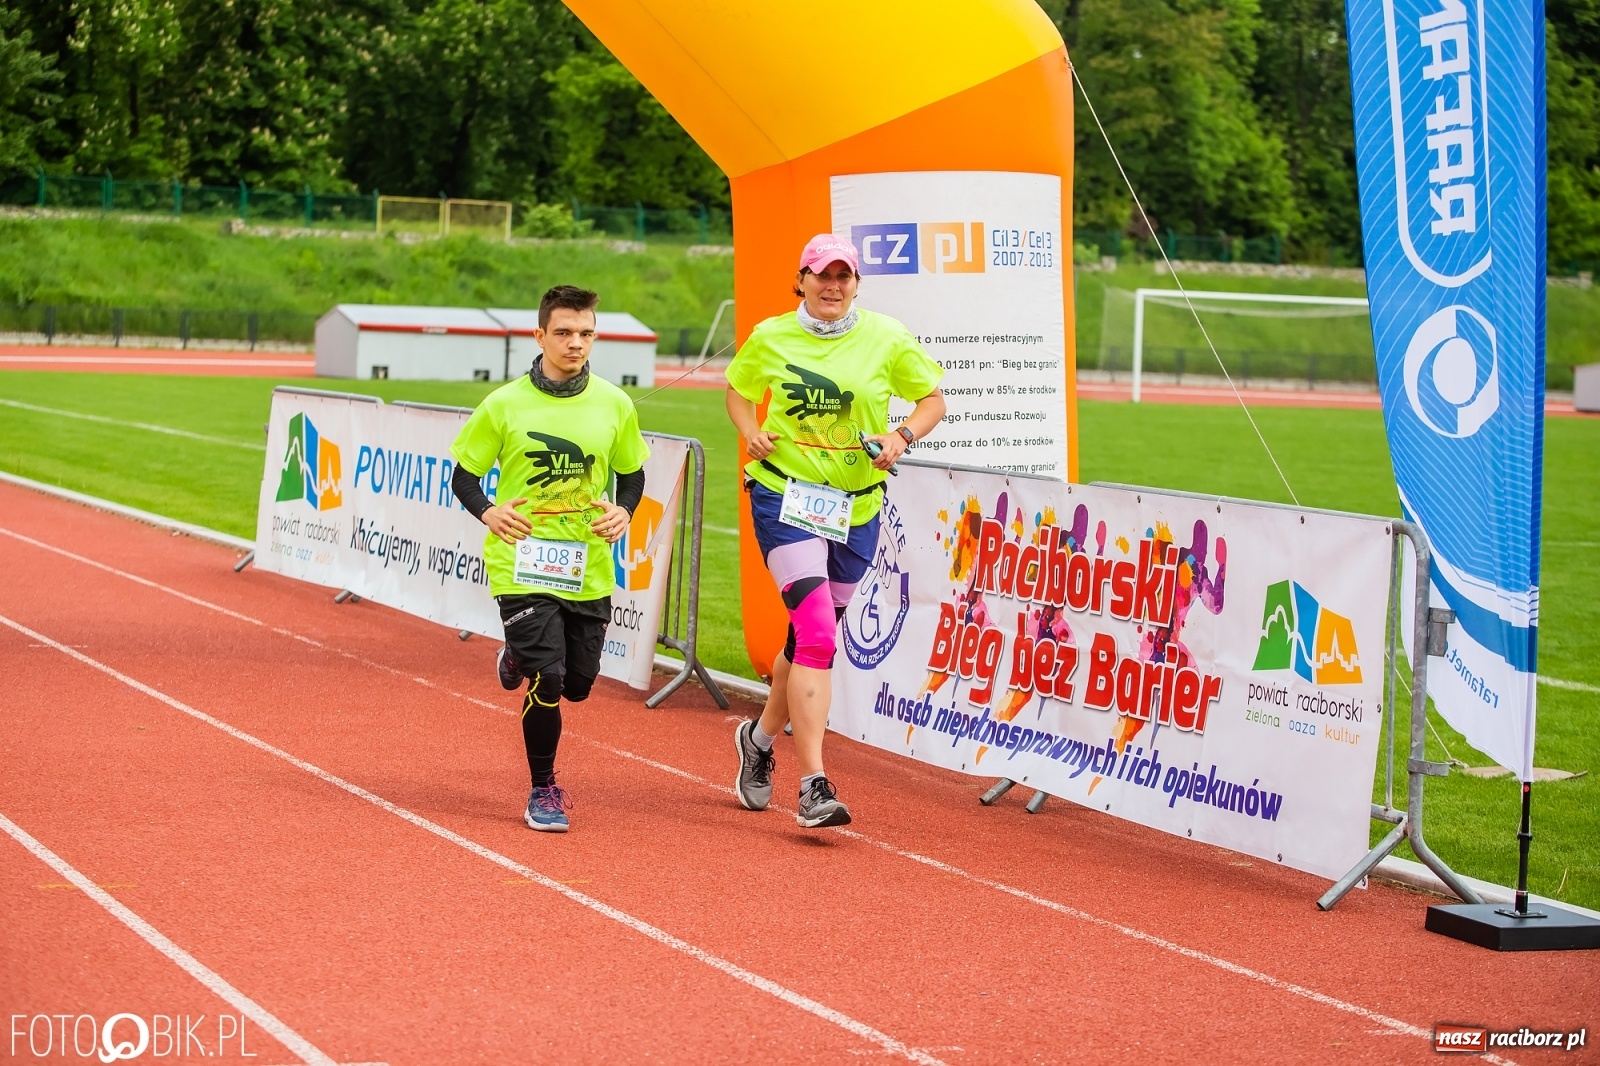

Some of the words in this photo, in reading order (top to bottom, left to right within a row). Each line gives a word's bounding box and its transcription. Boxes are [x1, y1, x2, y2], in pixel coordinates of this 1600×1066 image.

[935, 335, 980, 344] numerze
[982, 333, 1044, 345] rejestracyjnym
[979, 360, 995, 371] pn:
[1024, 360, 1037, 369] bez
[805, 388, 825, 404] VI
[997, 385, 1016, 395] 85%
[1029, 385, 1057, 395] środków
[964, 411, 1012, 422] Funduszu
[1014, 411, 1047, 422] Rozwoju
[950, 440, 972, 449] oraz
[976, 438, 988, 447] do
[992, 437, 1010, 447] 10%
[1012, 438, 1022, 447] ze
[1024, 437, 1054, 446] środków
[550, 453, 570, 469] VI
[354, 445, 437, 503] POWIAT
[803, 495, 838, 516] 107
[841, 500, 849, 511] R
[536, 546, 569, 566] 108
[575, 551, 583, 561] R
[976, 519, 1179, 626] Raciborski
[929, 603, 1003, 706] Bieg
[1011, 612, 1077, 701] bez
[1085, 634, 1222, 733] Barier
[1247, 682, 1289, 706] powiat
[1296, 691, 1363, 722] raciborski
[1246, 707, 1280, 727] zielona
[1288, 719, 1316, 736] oaza
[1325, 724, 1360, 745] kultur
[874, 682, 895, 718] dla
[1117, 745, 1132, 779] i
[1125, 747, 1162, 789] ich
[1162, 762, 1283, 822] opiekunów
